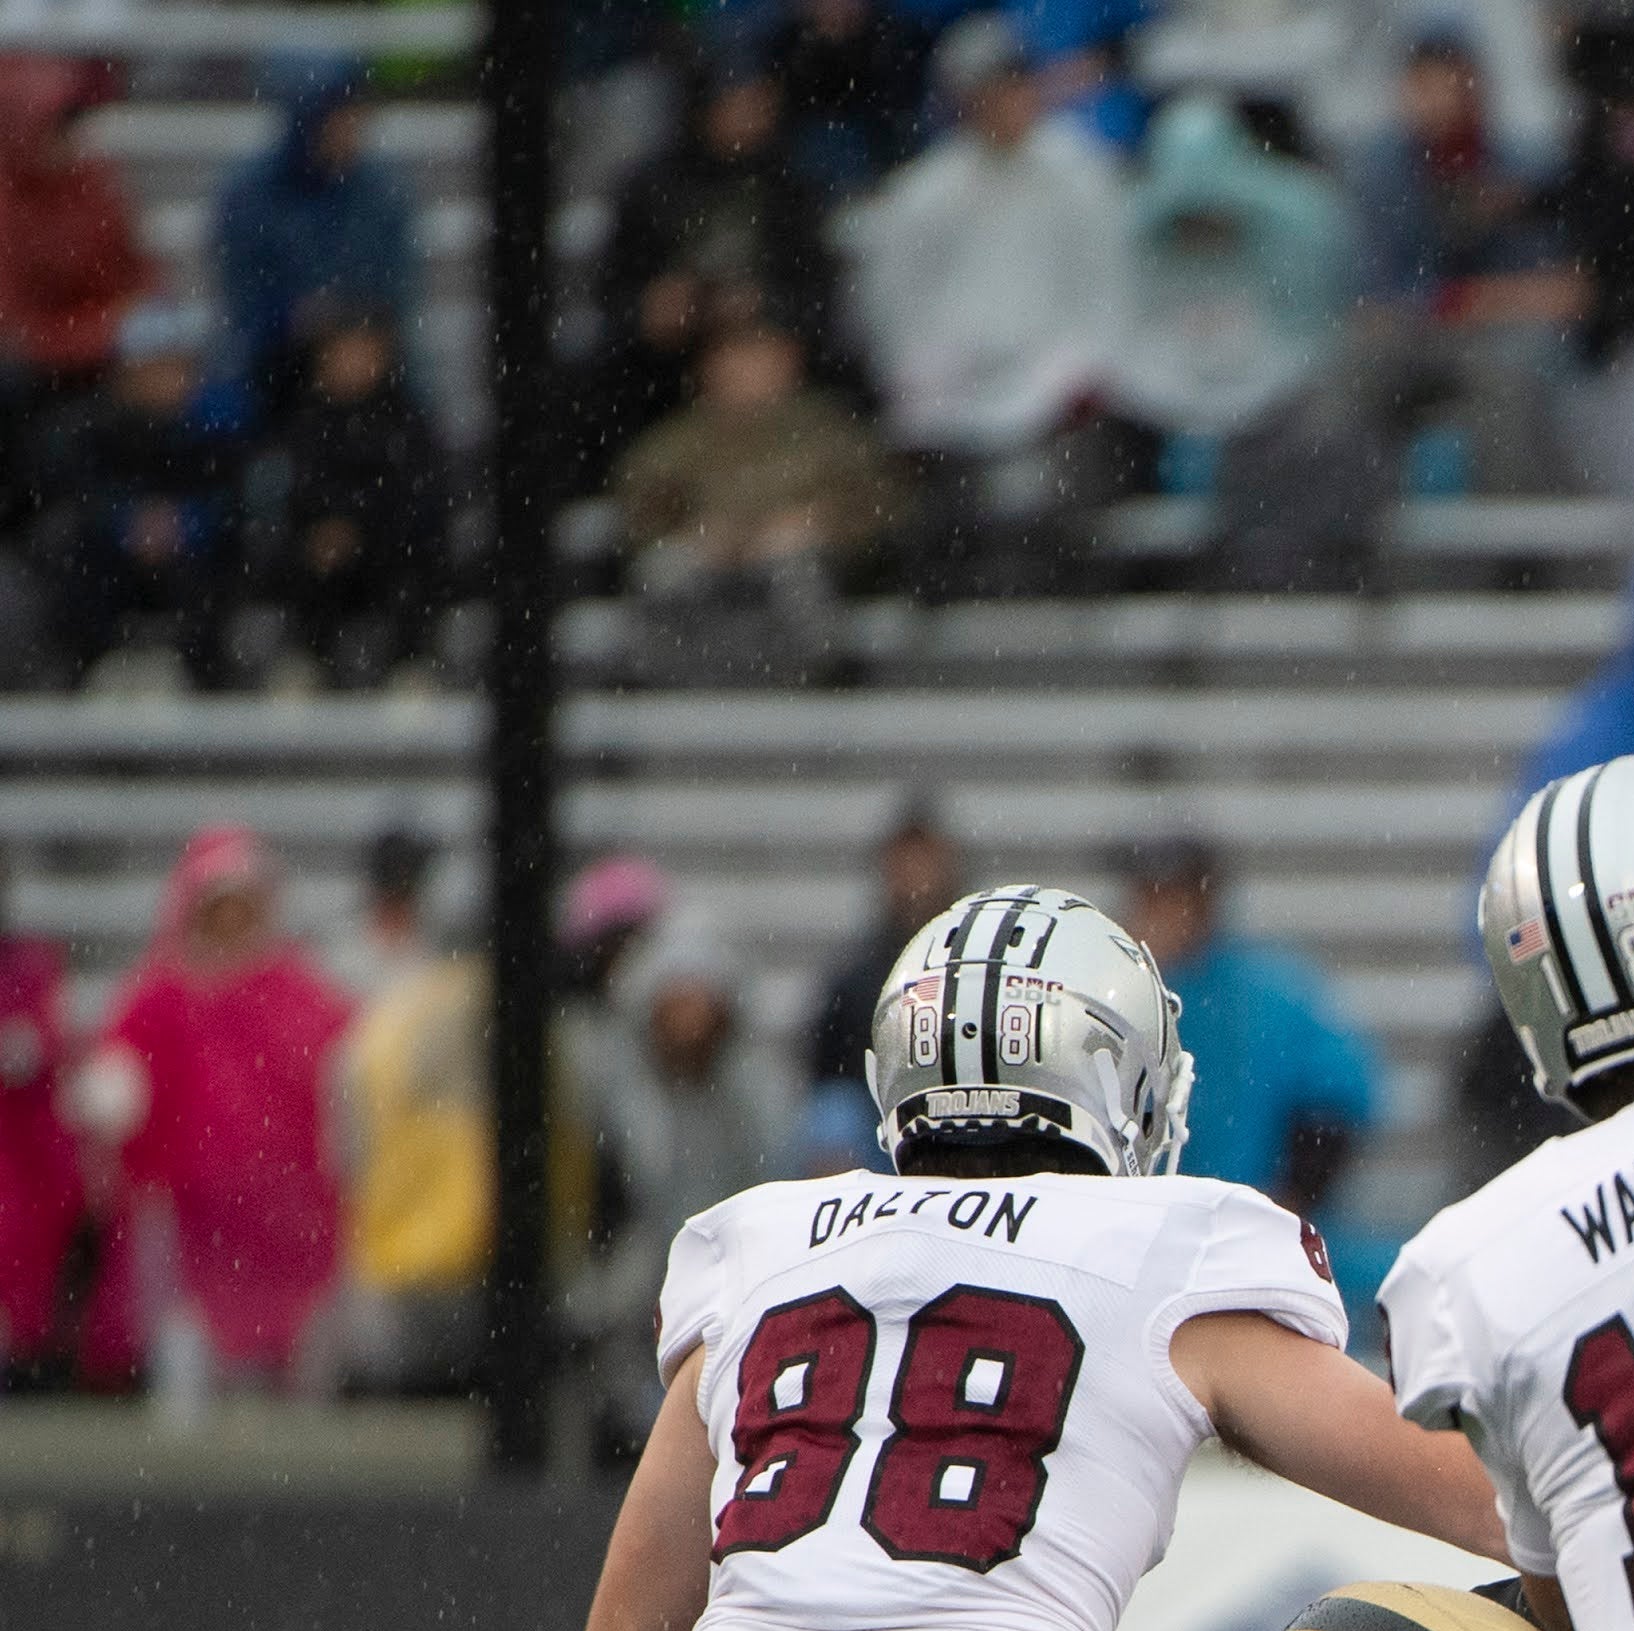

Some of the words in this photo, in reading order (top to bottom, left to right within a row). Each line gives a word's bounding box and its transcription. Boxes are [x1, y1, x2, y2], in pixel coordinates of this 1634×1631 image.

[1004, 975, 1065, 1006] SBC
[925, 1090, 1021, 1119] TROJANS
[808, 1190, 1039, 1250] DALTON
[710, 1283, 1087, 1575] 88
